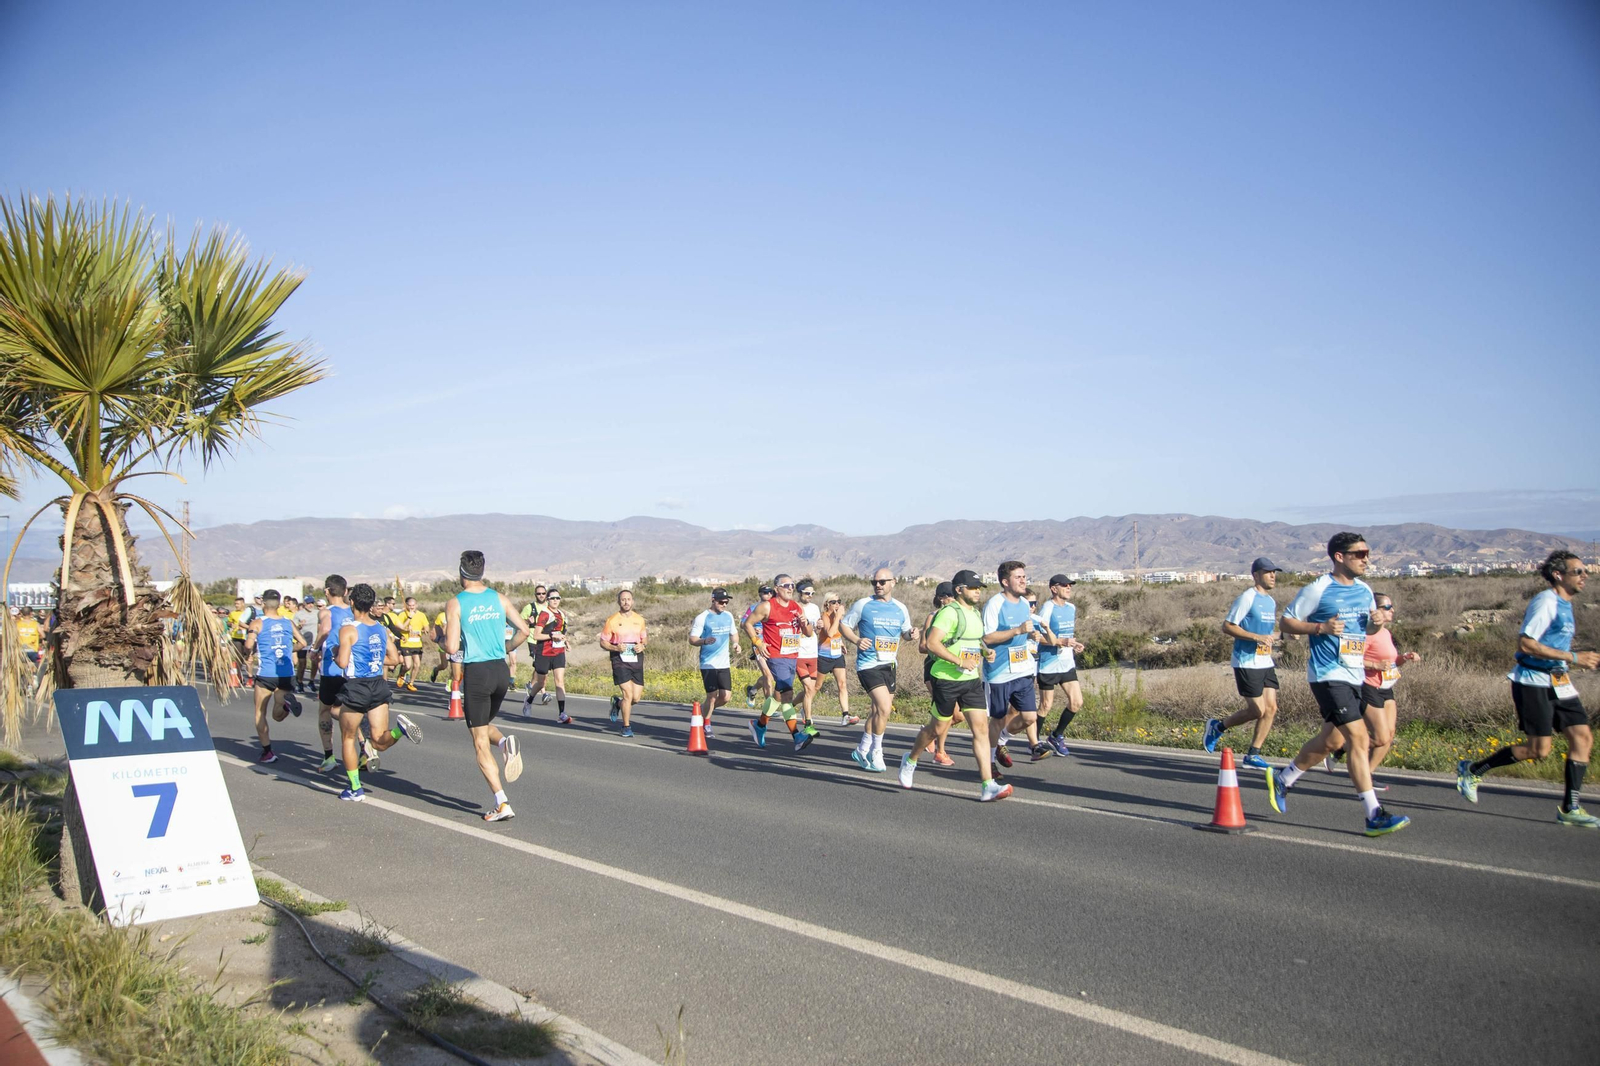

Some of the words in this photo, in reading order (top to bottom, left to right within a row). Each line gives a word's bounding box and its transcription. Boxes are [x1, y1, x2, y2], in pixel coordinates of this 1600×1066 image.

[468, 612, 500, 624] GUADIX
[878, 641, 897, 649] 2577
[112, 766, 188, 780] KILÓMETRO
[131, 782, 178, 839] 7
[145, 867, 169, 877] NEXAL
